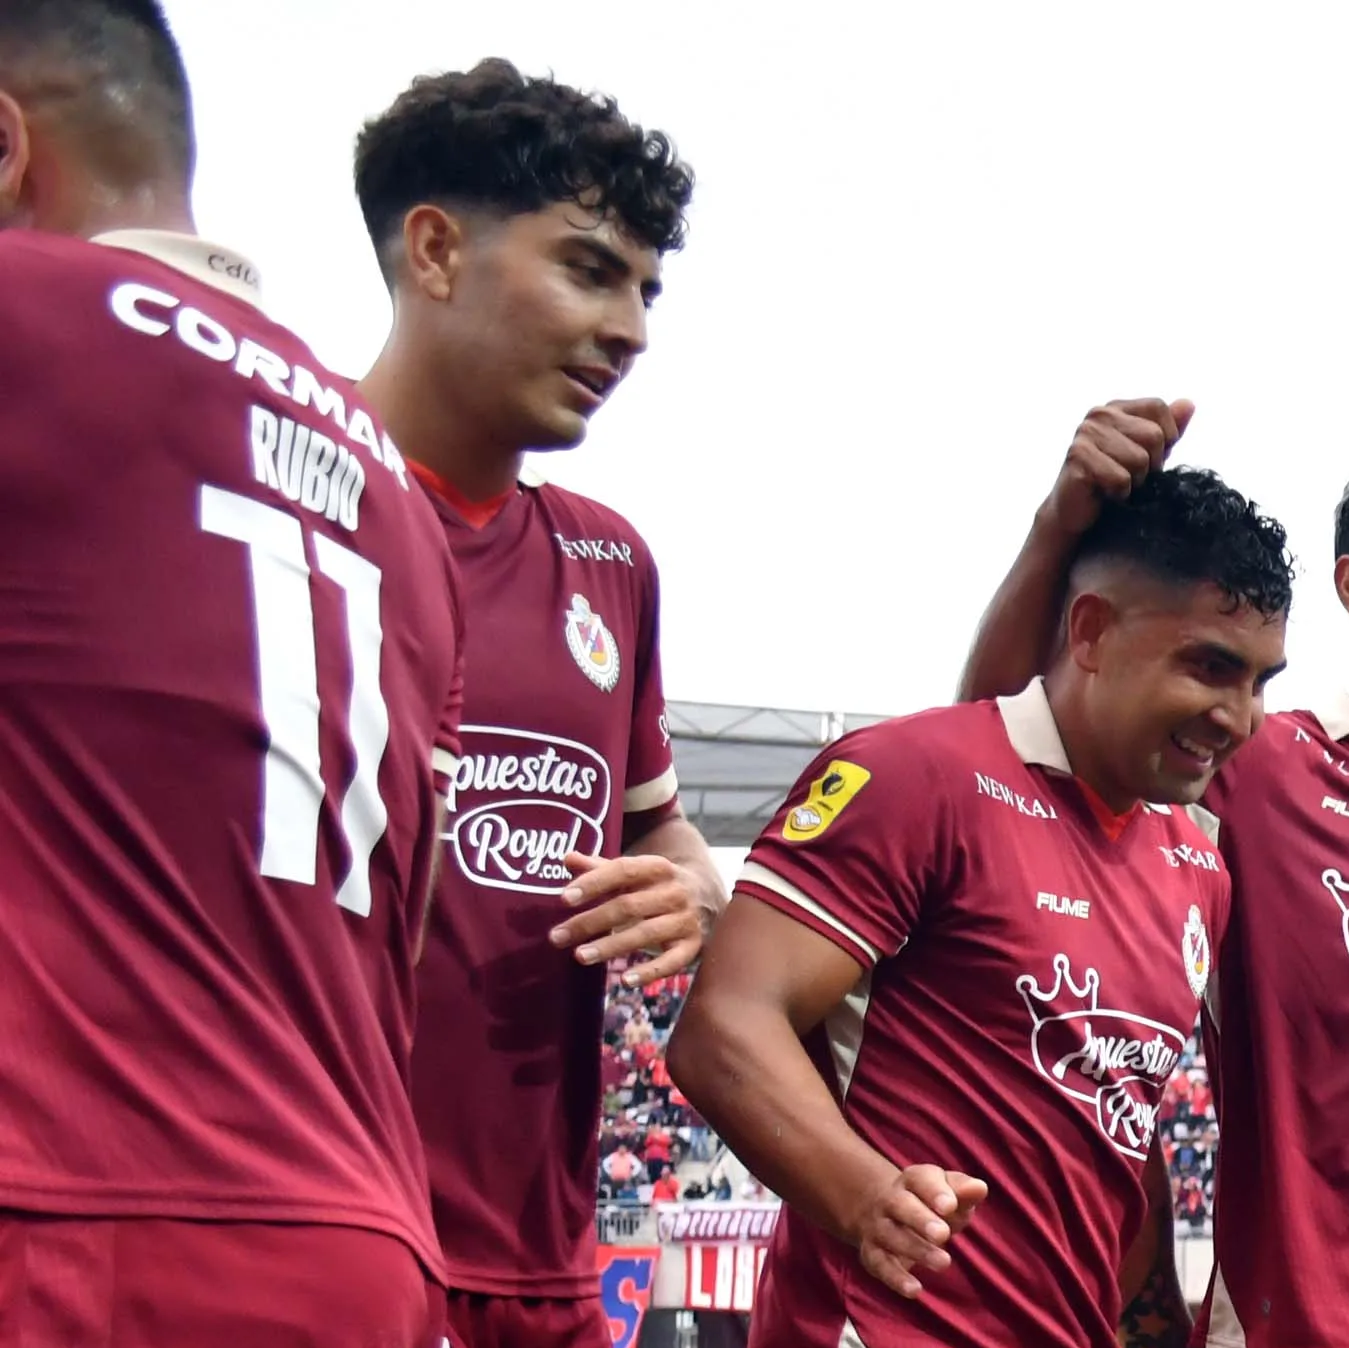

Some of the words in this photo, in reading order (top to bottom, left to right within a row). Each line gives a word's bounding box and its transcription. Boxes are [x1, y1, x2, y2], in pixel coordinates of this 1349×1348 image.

[251, 404, 366, 532] RUBIO
[200, 484, 390, 918] 11
[447, 747, 597, 812] puestas
[469, 813, 582, 881] Royal
[1036, 892, 1090, 919] FIUME
